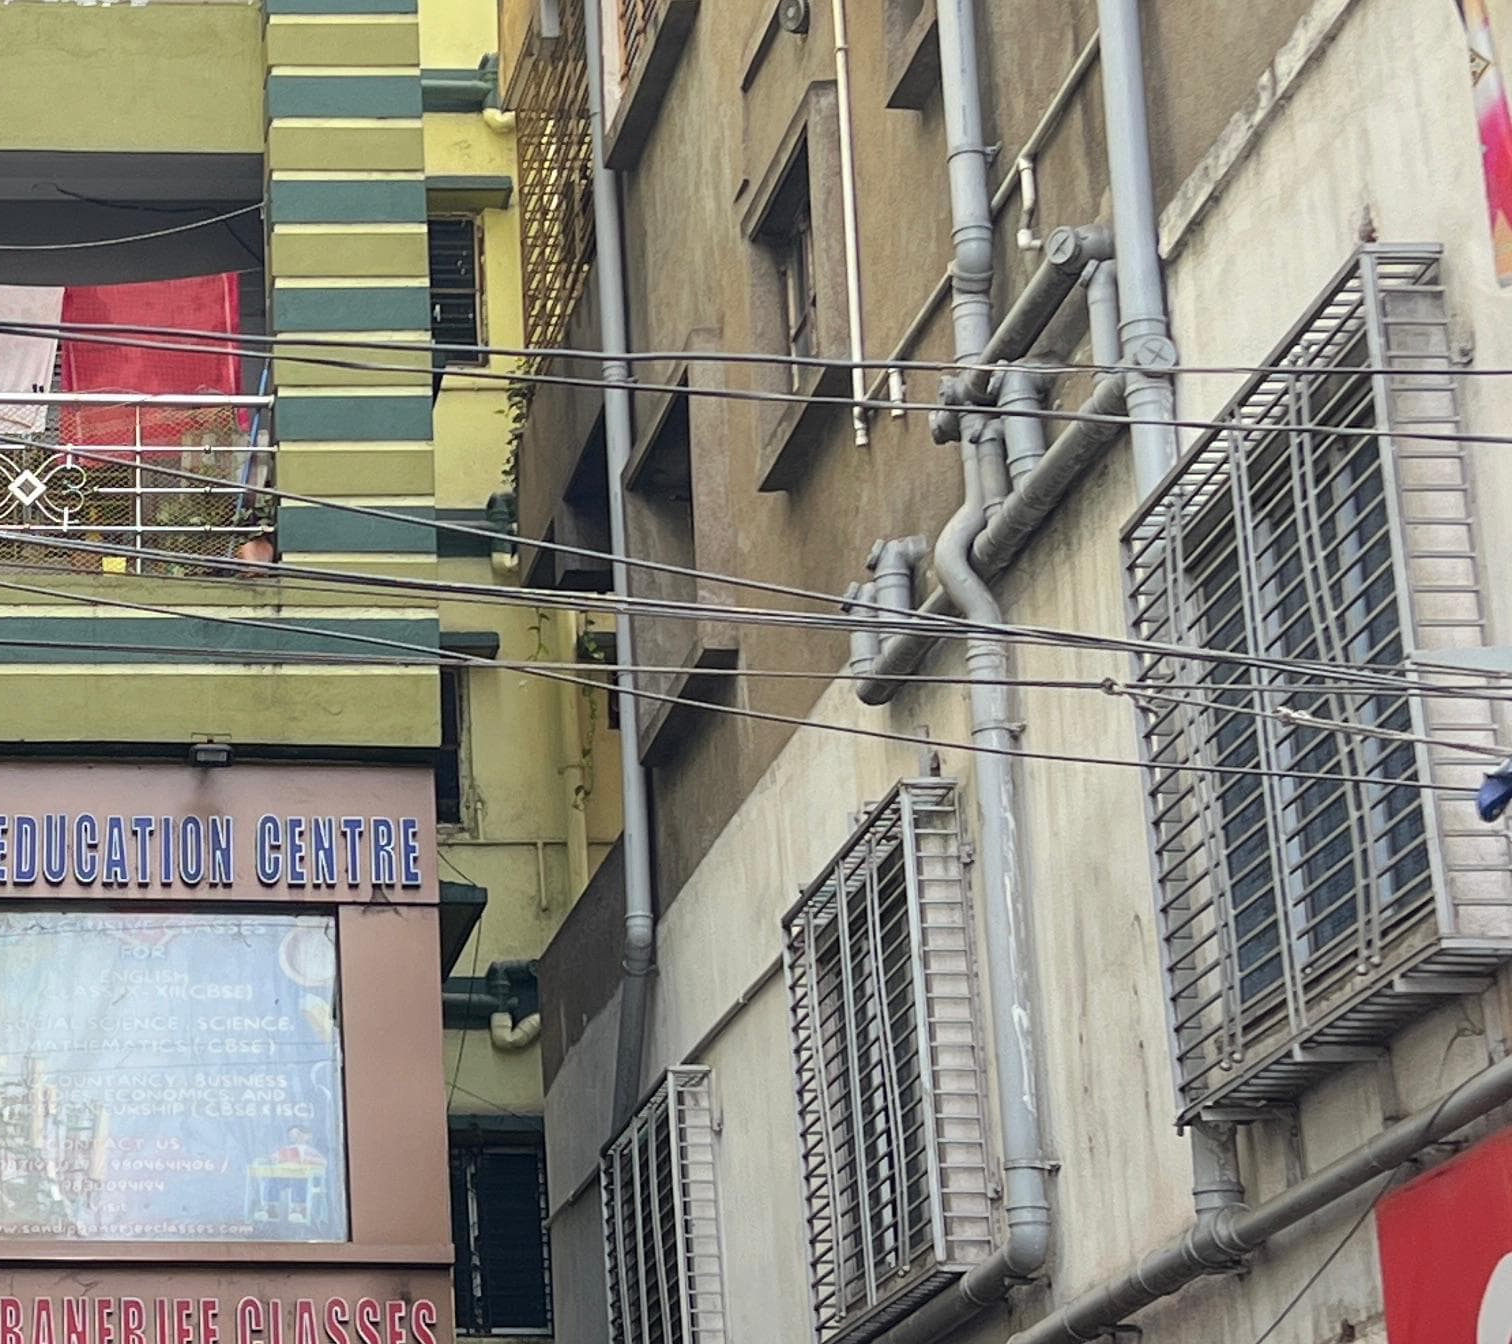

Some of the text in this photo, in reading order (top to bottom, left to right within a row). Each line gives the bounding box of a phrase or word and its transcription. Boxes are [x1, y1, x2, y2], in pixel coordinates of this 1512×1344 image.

[255, 815, 423, 888] CENTRE
[120, 946, 167, 960] FOR
[240, 1088, 286, 1102] AND
